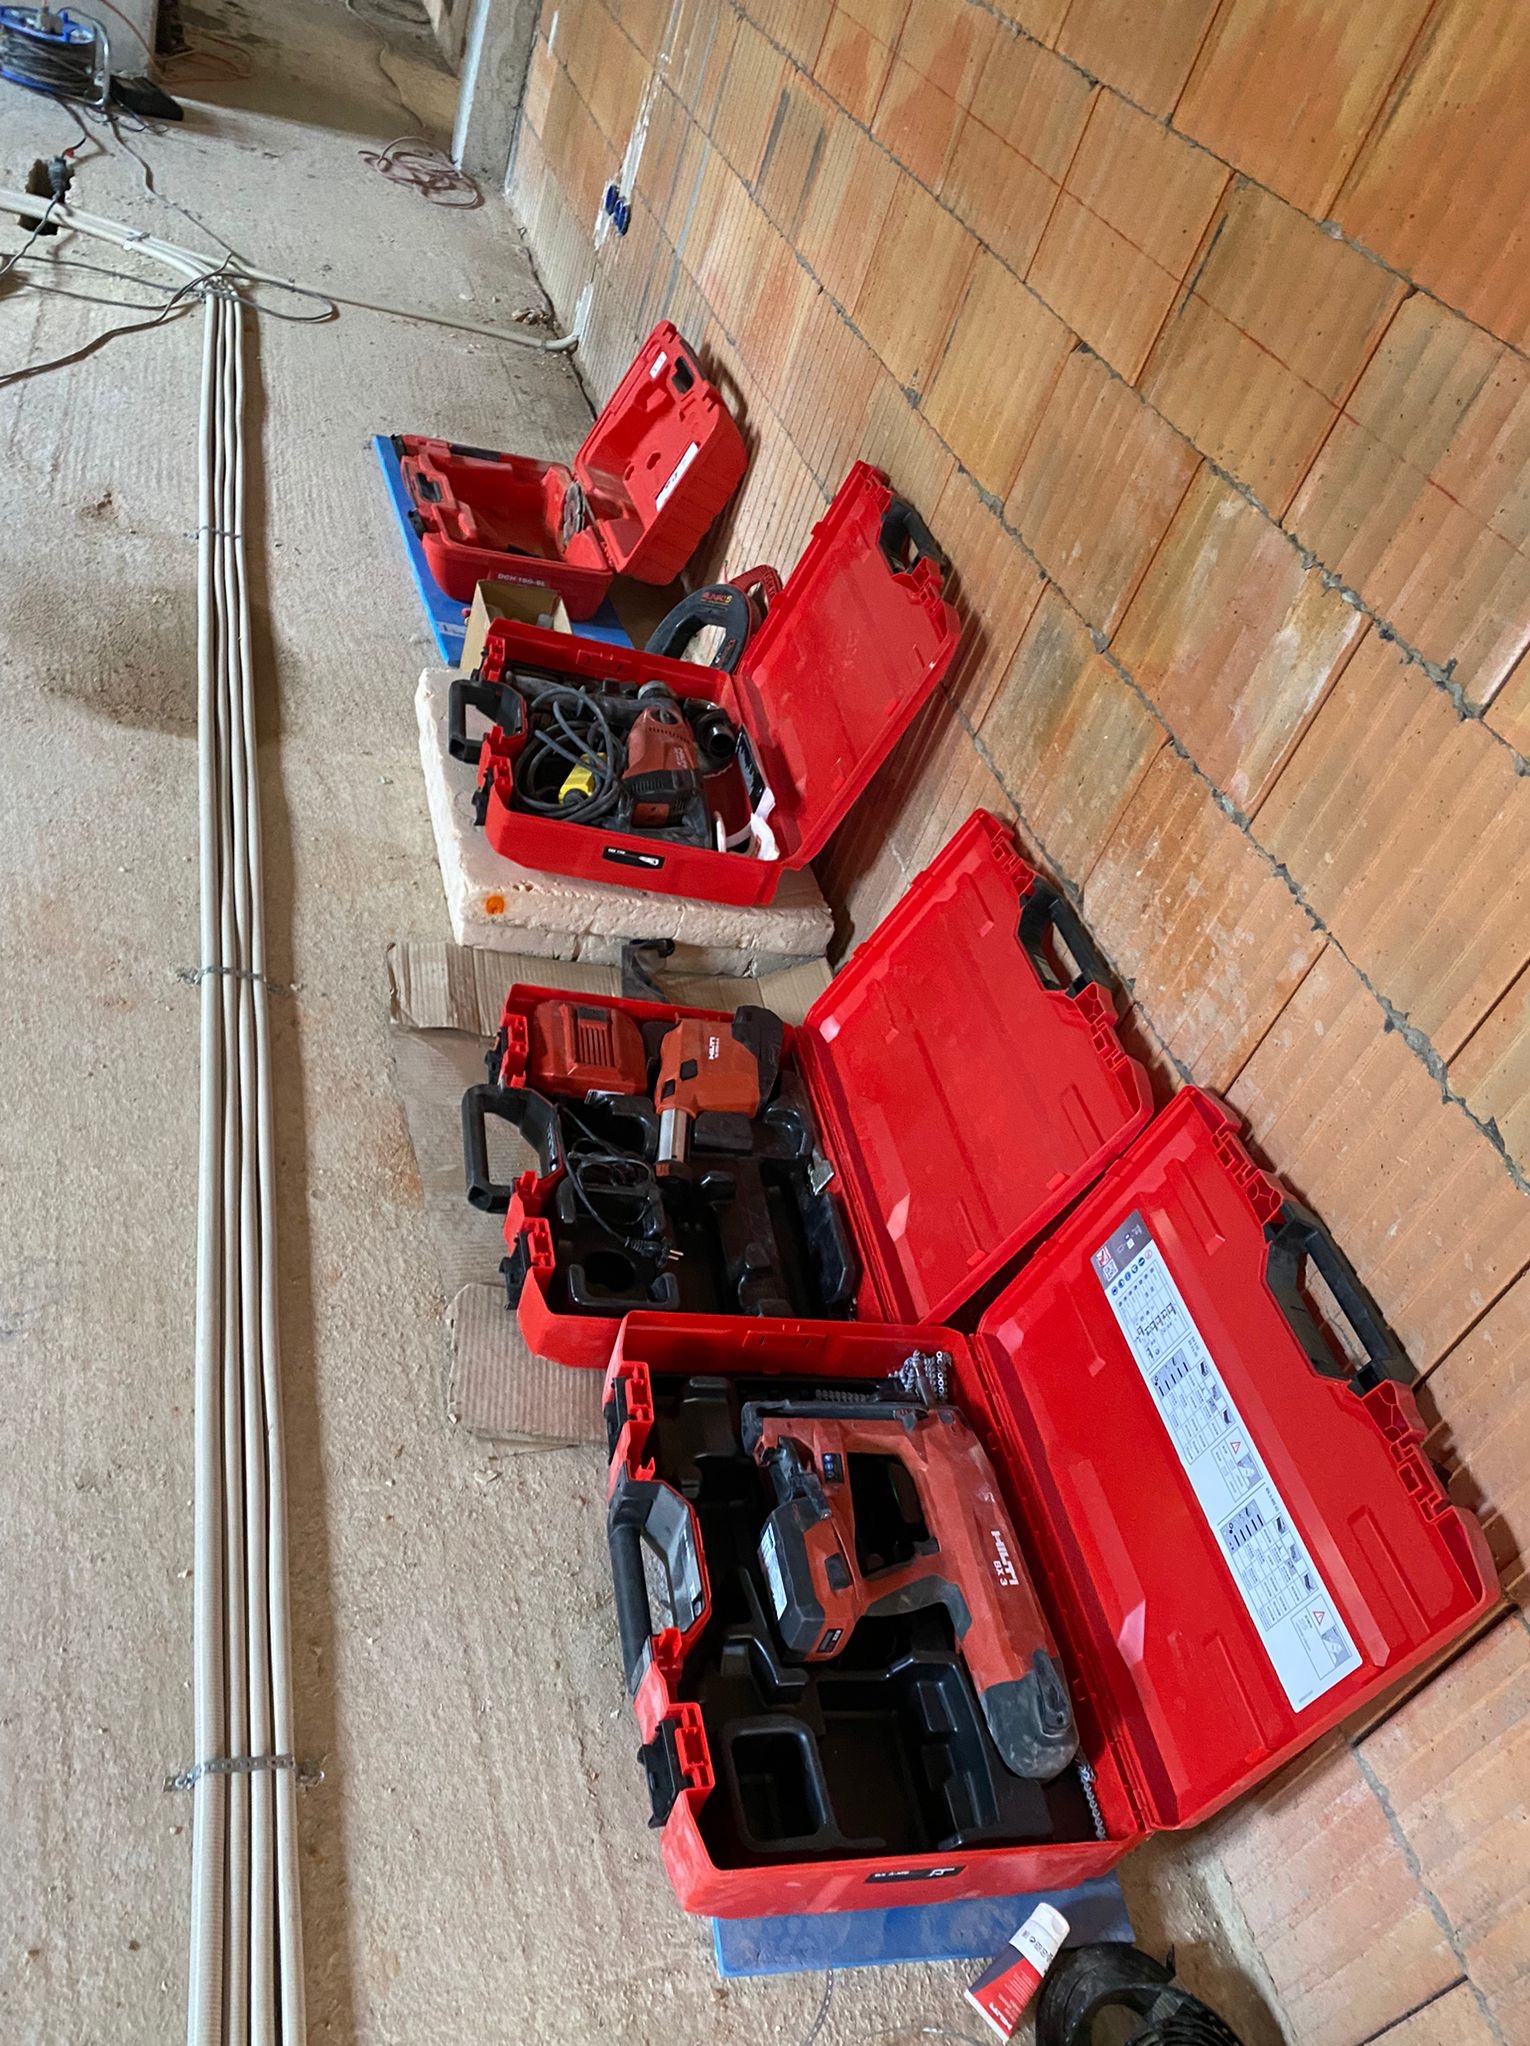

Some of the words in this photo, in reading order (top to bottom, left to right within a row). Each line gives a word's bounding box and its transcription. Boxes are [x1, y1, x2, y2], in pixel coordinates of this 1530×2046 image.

[991, 1530, 1019, 1585] HILTI
[993, 1560, 1005, 1576] BX
[1000, 1577, 1008, 1586] 3
